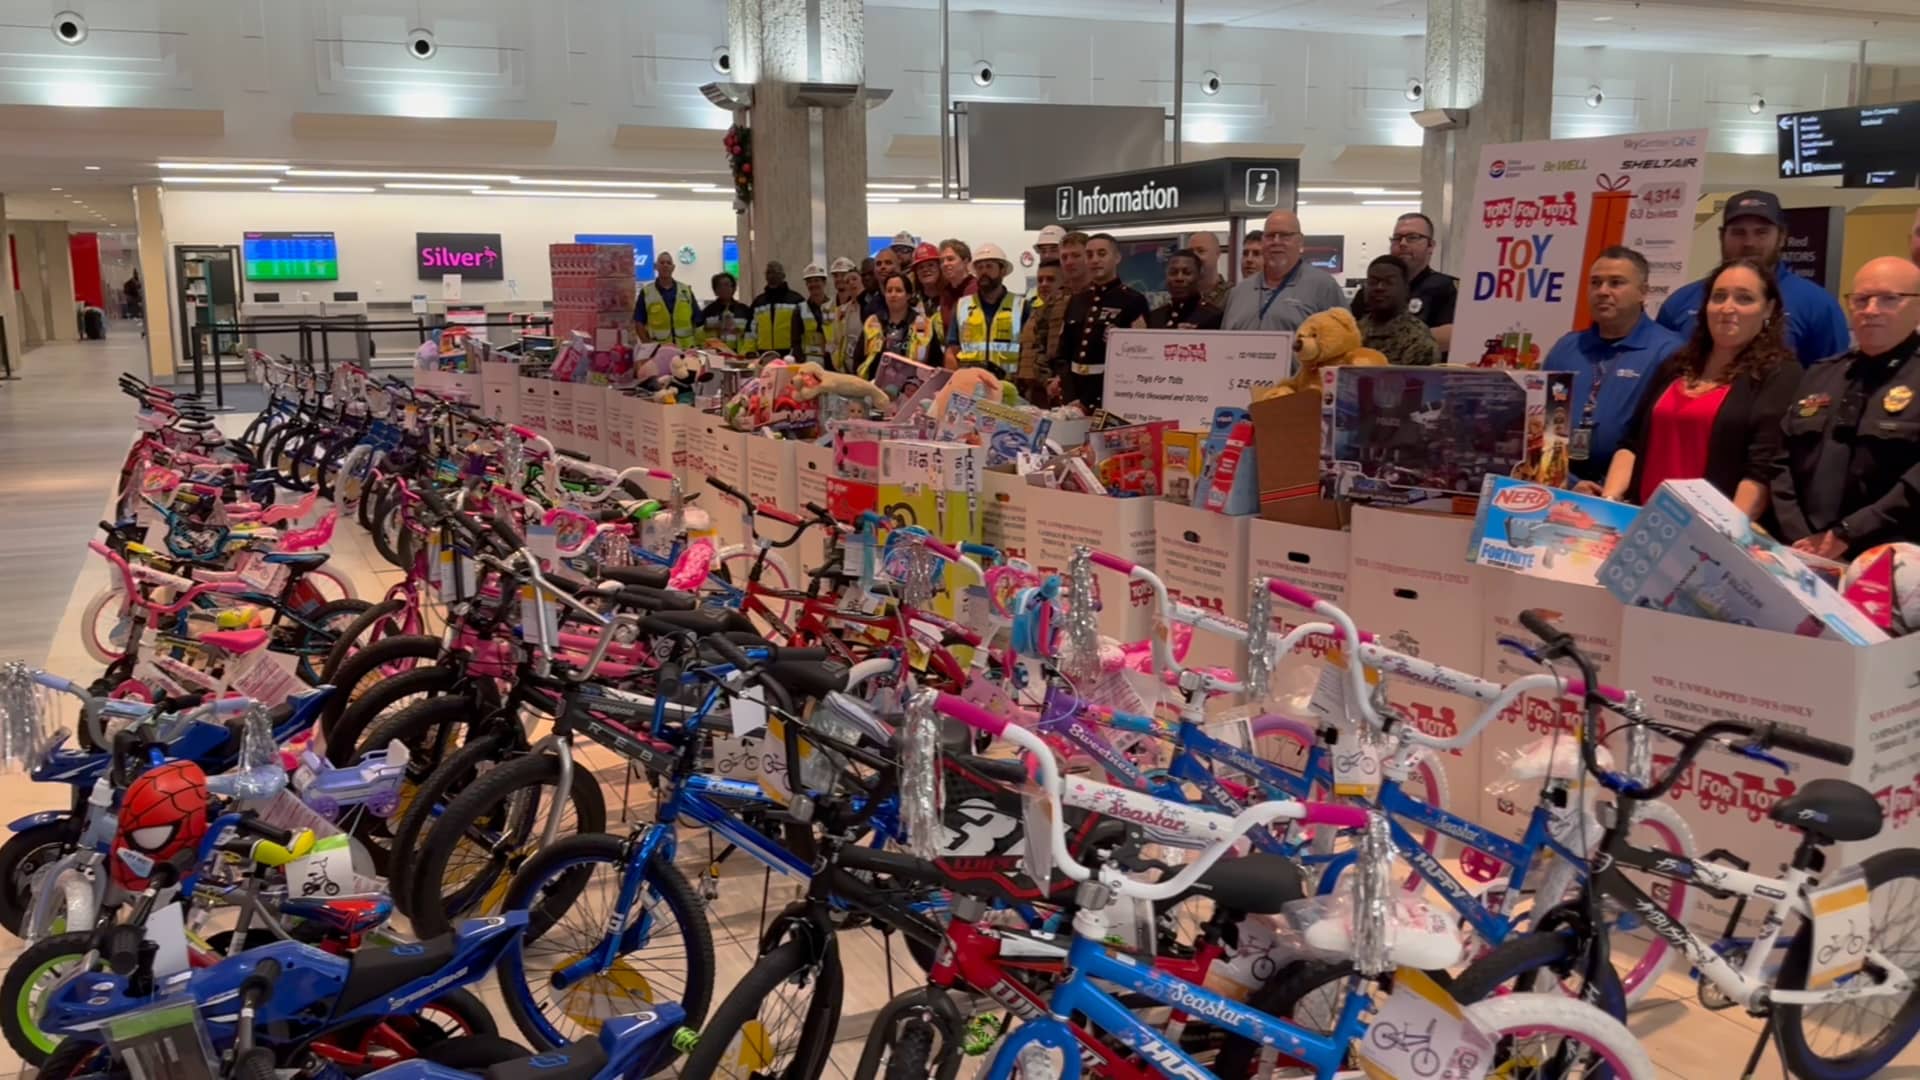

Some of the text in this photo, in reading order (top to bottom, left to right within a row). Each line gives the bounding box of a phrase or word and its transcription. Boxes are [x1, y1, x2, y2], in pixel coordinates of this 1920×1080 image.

[1620, 158, 1698, 170] SHELTAIR
[1077, 181, 1179, 216] Information
[422, 247, 483, 267] Silver
[1496, 234, 1553, 270] TOY
[1473, 268, 1565, 303] DRIVE
[1137, 374, 1184, 385] Toys For Tots
[1494, 485, 1547, 505] NERF
[1480, 543, 1535, 568] FORTNITE
[1527, 701, 1553, 723] FOR
[1653, 694, 1709, 715] CAMPAIGN
[1067, 722, 1138, 781] Sweetness
[1699, 774, 1734, 801] FOR
[1107, 800, 1185, 831] Seastar
[1414, 852, 1467, 898] HUFFY
[1170, 983, 1245, 1026] Seastar
